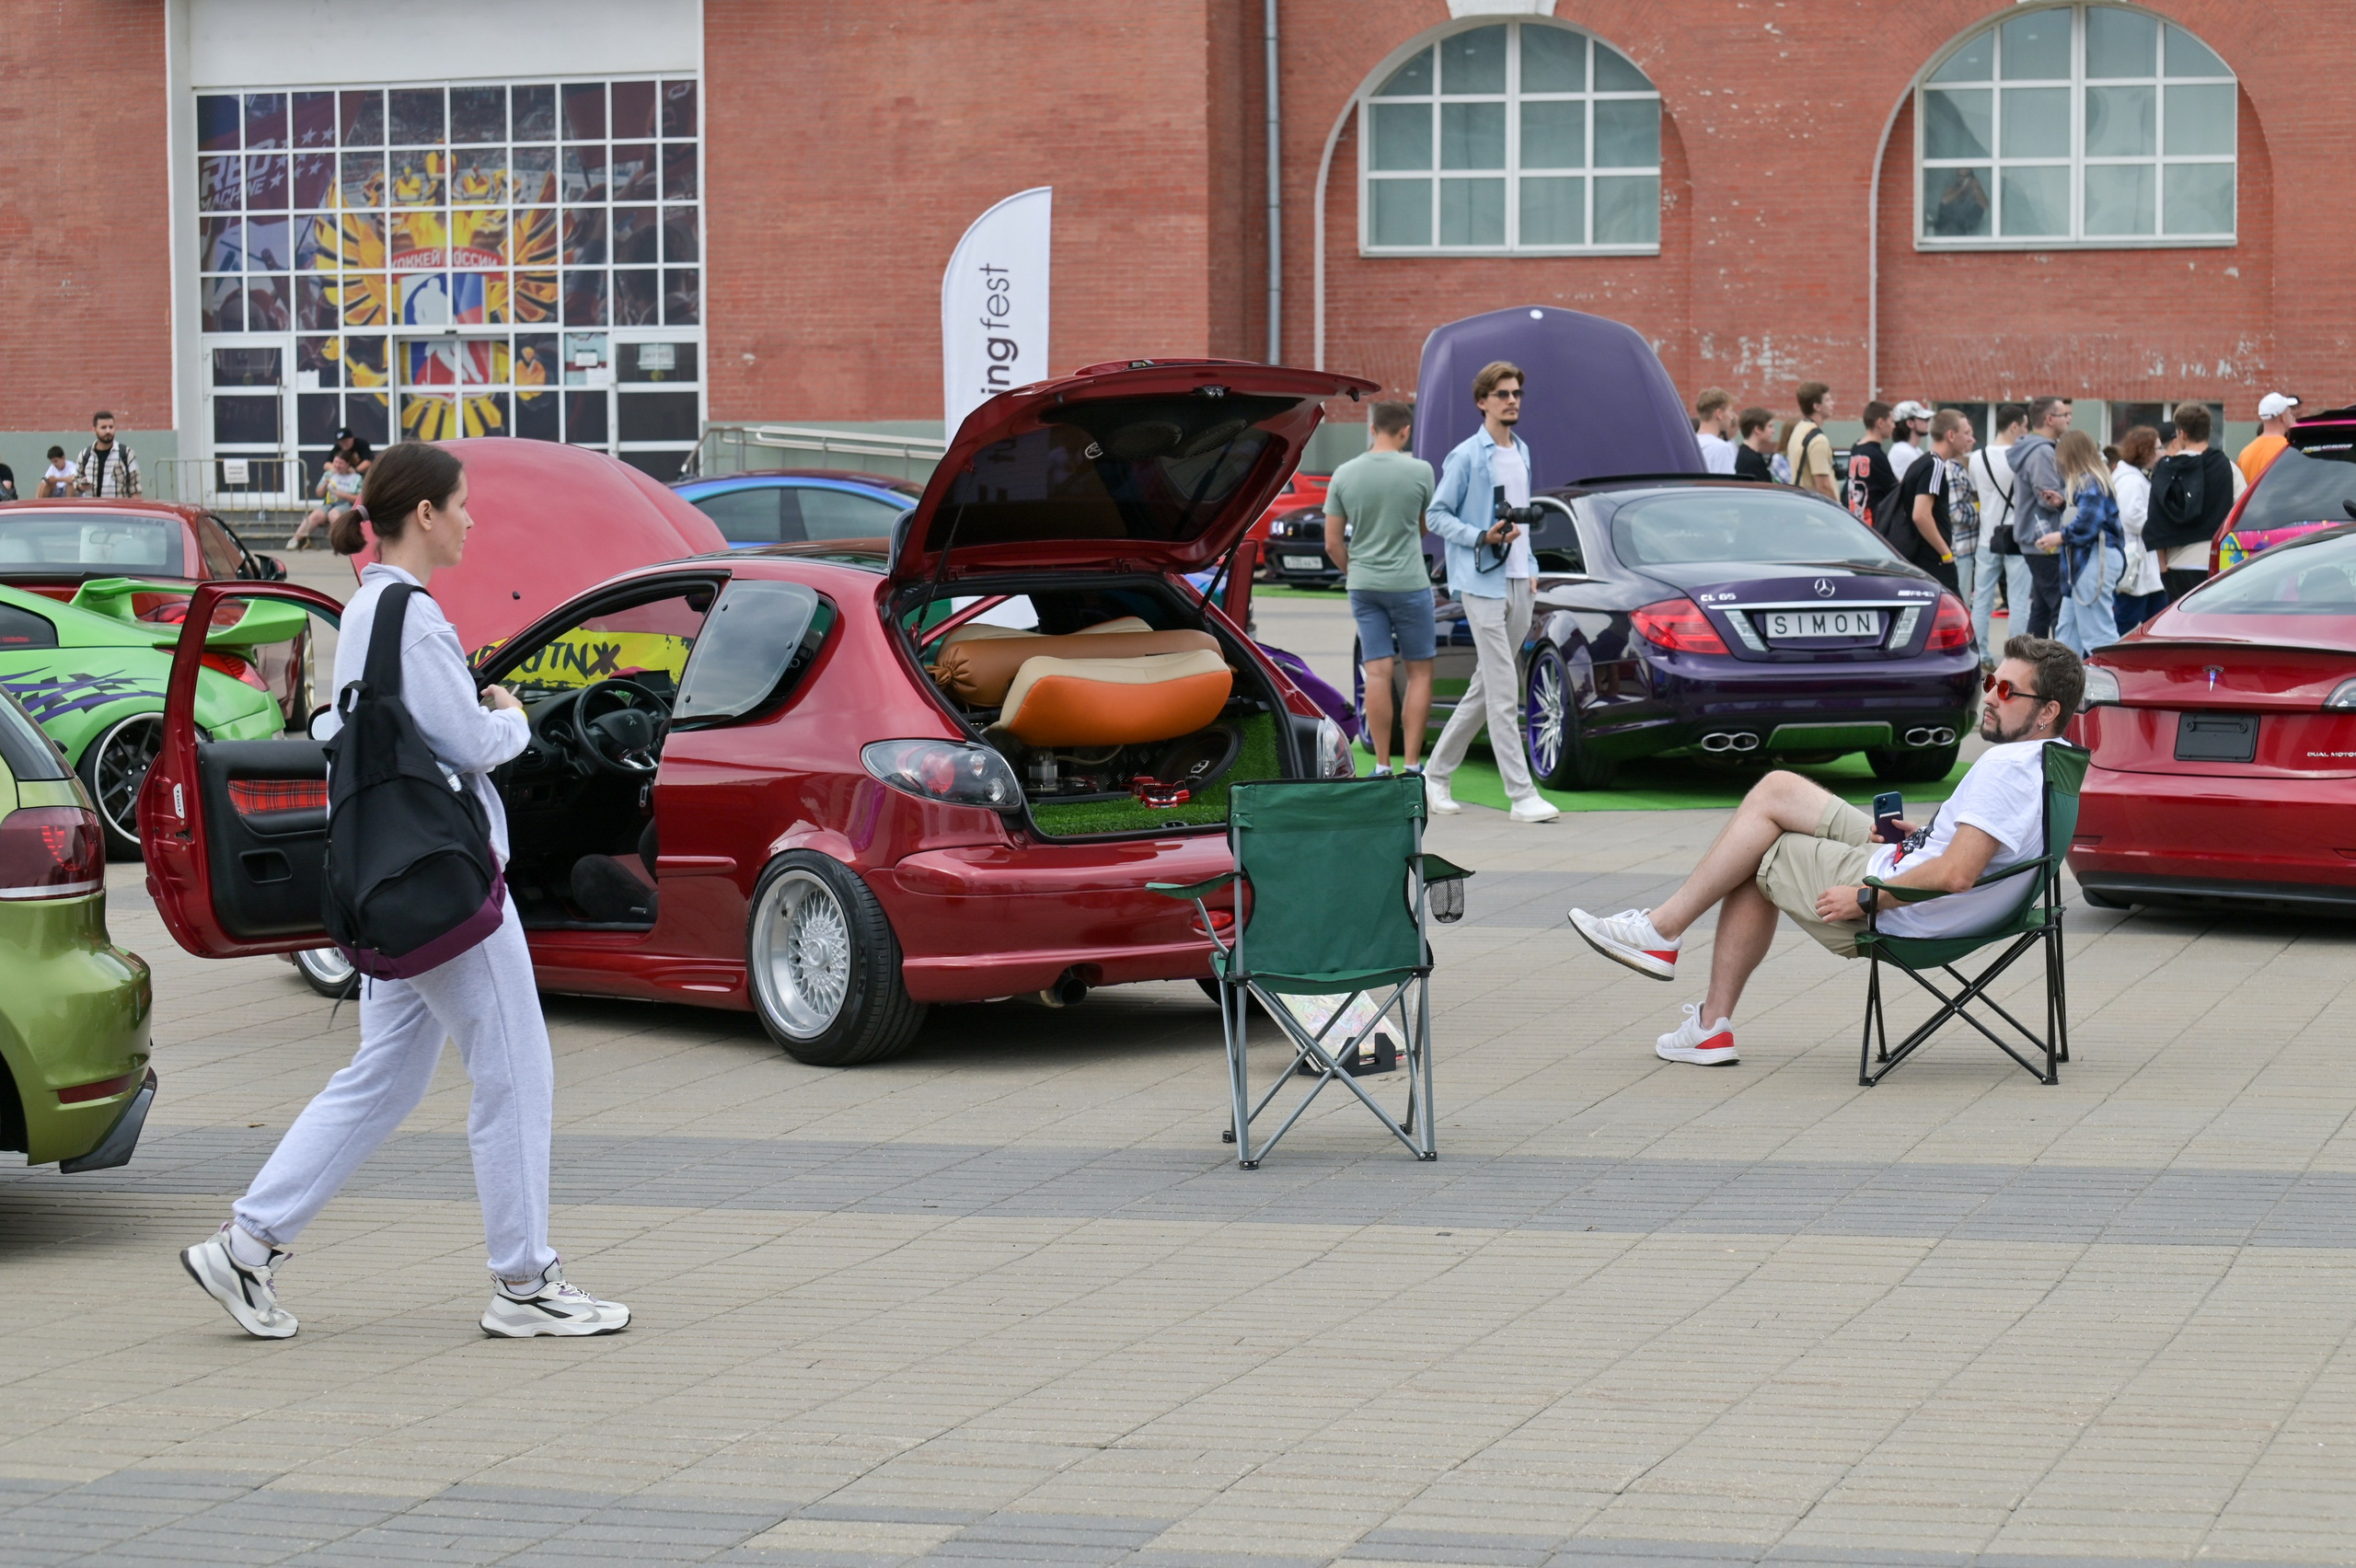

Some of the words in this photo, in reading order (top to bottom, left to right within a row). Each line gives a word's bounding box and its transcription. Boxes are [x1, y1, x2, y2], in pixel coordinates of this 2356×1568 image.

[200, 137, 276, 198] RED
[200, 176, 267, 212] MACHNE
[445, 249, 498, 267] ОССИИ
[1719, 593, 1737, 601] 65
[1774, 614, 1870, 635] SIMON
